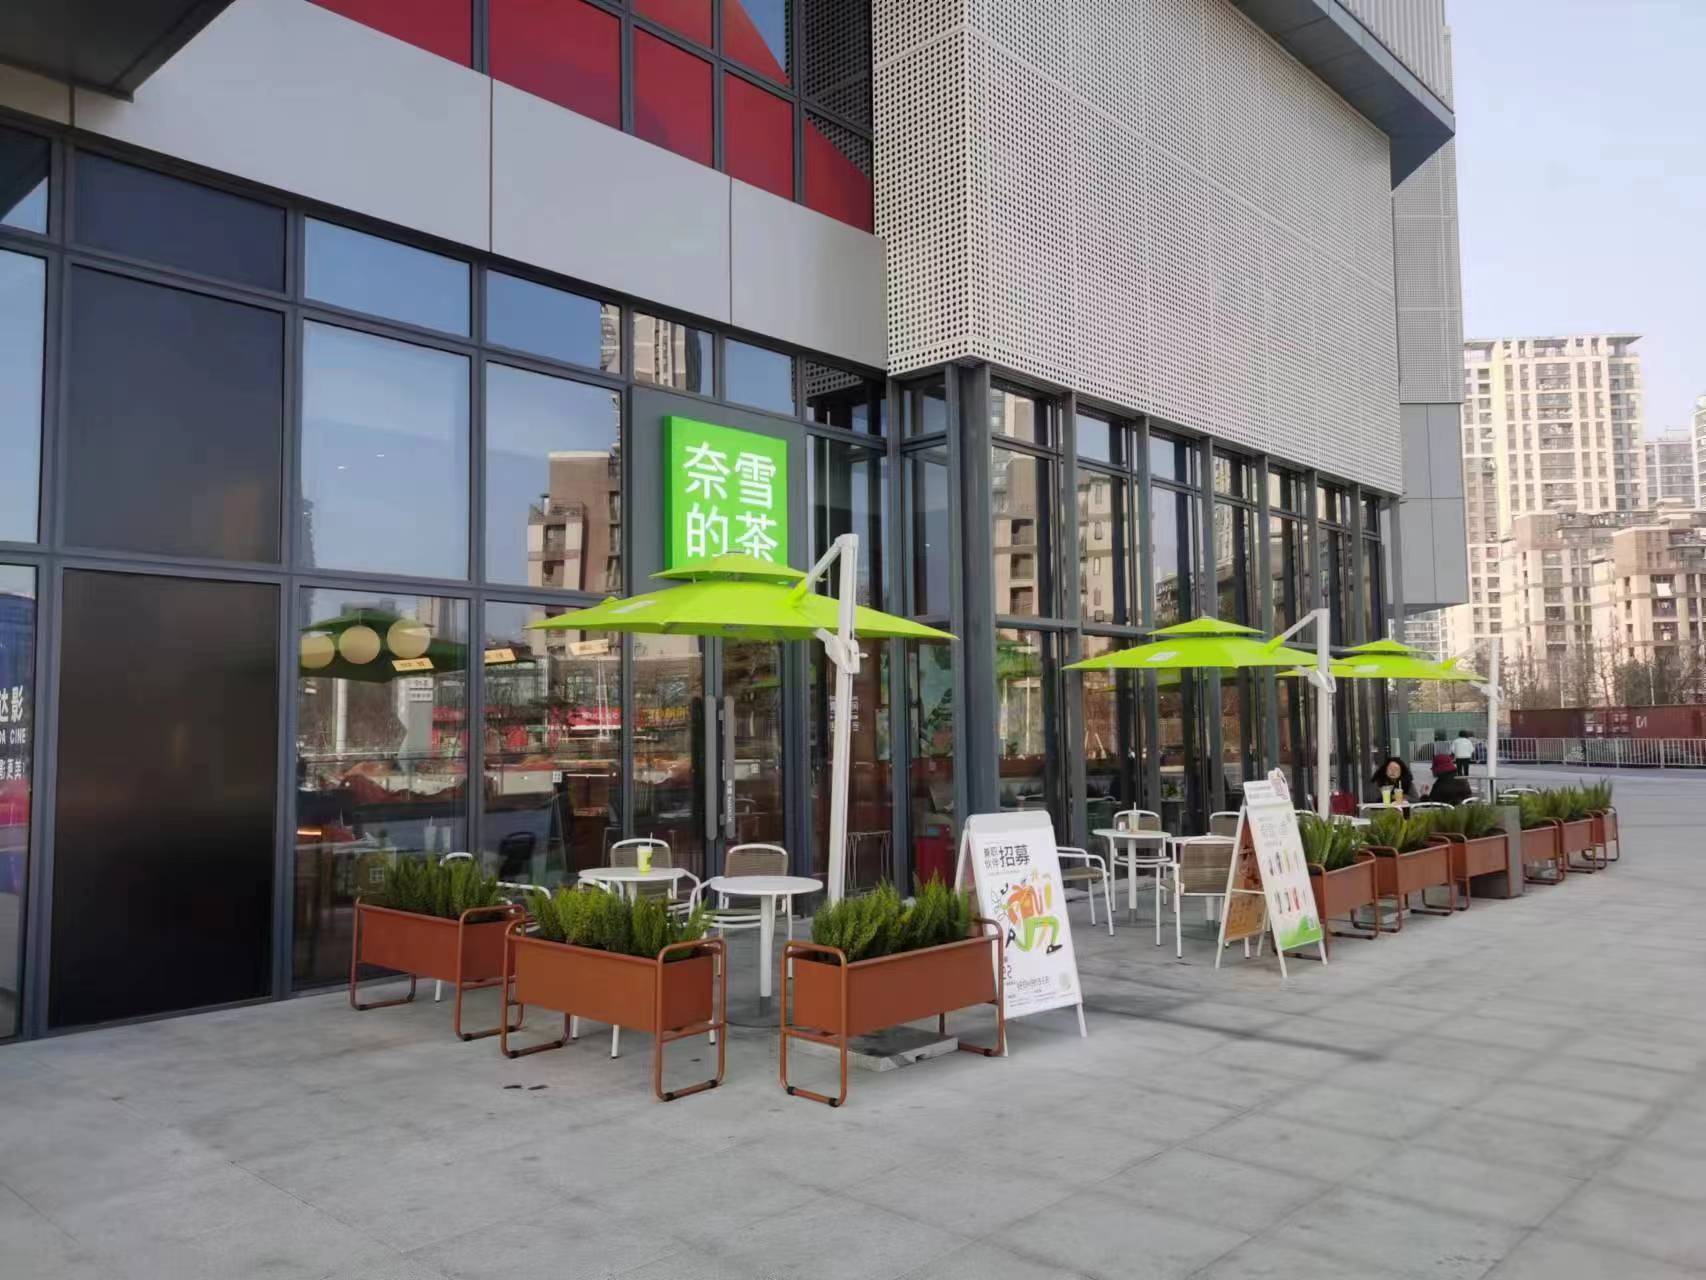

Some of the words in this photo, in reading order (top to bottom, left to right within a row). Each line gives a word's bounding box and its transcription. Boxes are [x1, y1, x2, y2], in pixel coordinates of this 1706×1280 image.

[683, 441, 777, 509] 奈雪
[686, 502, 778, 562] 的茶
[999, 844, 1030, 868] 招募
